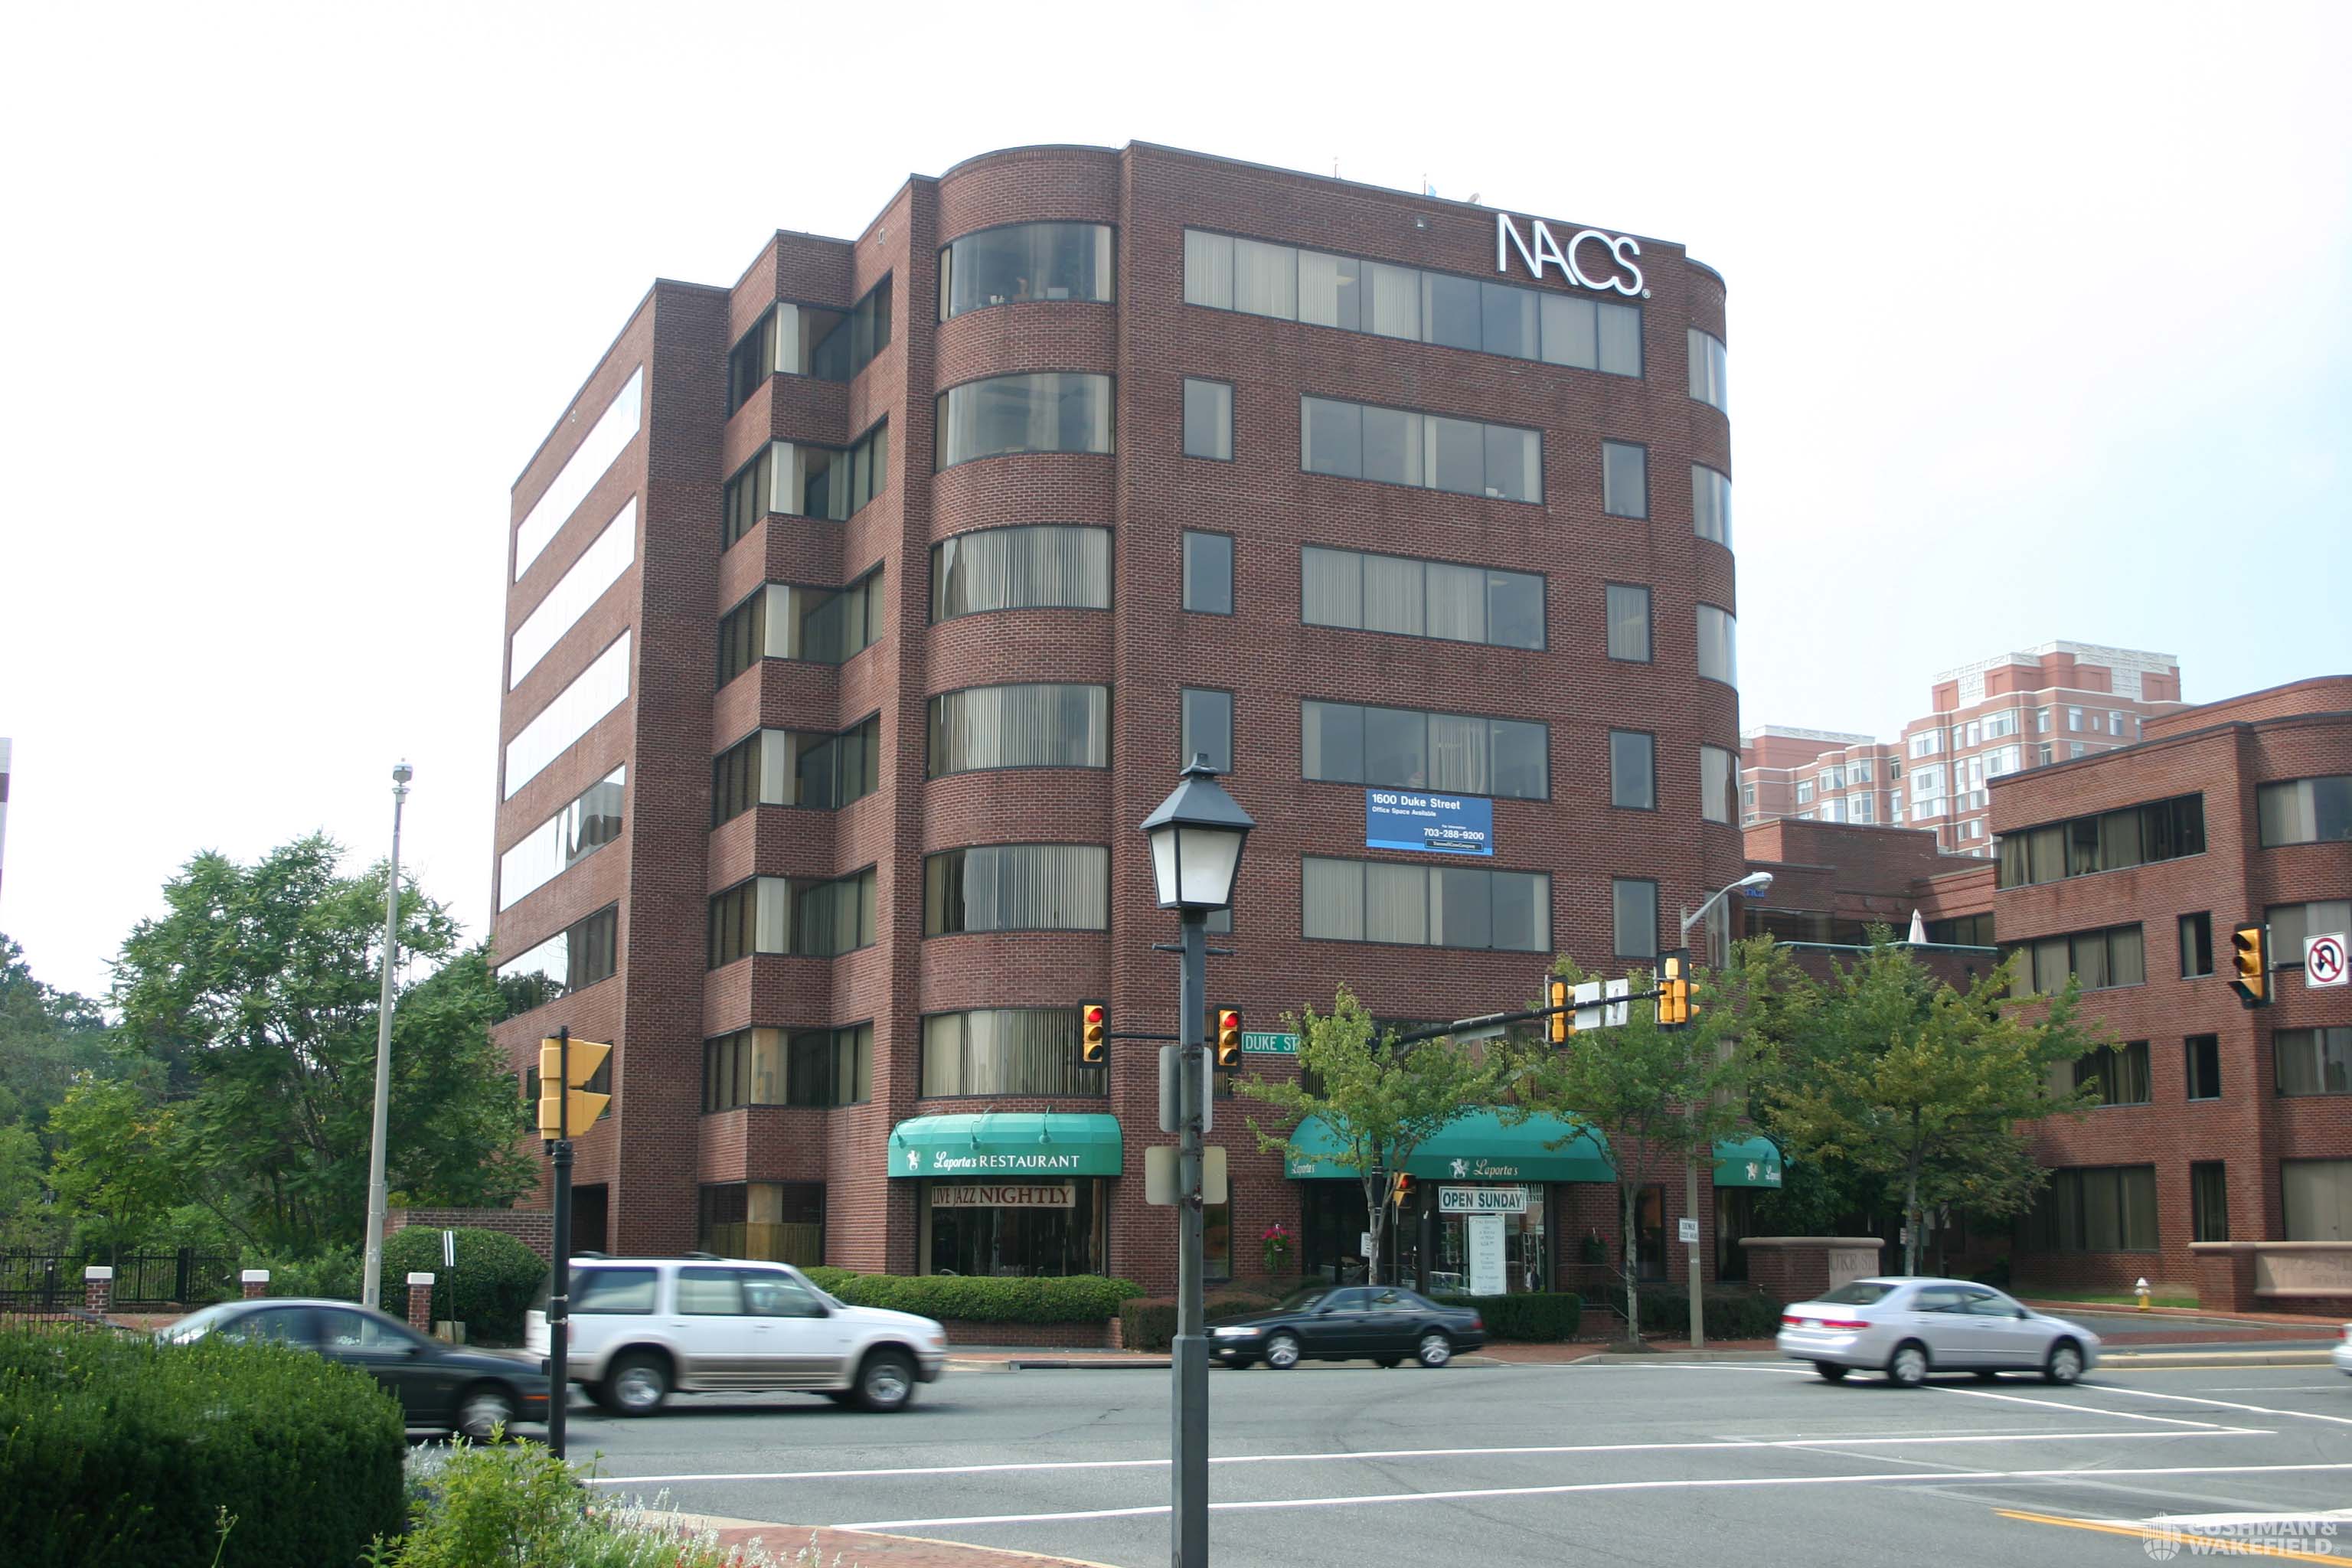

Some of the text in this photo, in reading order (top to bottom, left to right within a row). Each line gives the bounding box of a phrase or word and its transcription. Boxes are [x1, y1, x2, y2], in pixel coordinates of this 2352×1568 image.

[1372, 793, 1461, 810] 1600 Duke Street
[1411, 809, 1437, 818] Available
[1423, 828, 1485, 841] 703-288-9200
[1245, 1035, 1298, 1052] DUKE ST
[933, 1151, 1080, 1172] Laporta's RESTAURANT
[933, 1187, 1070, 1207] LIVE JAZZ NIGHTLY
[1442, 1192, 1523, 1208] OPEN SUNDAY
